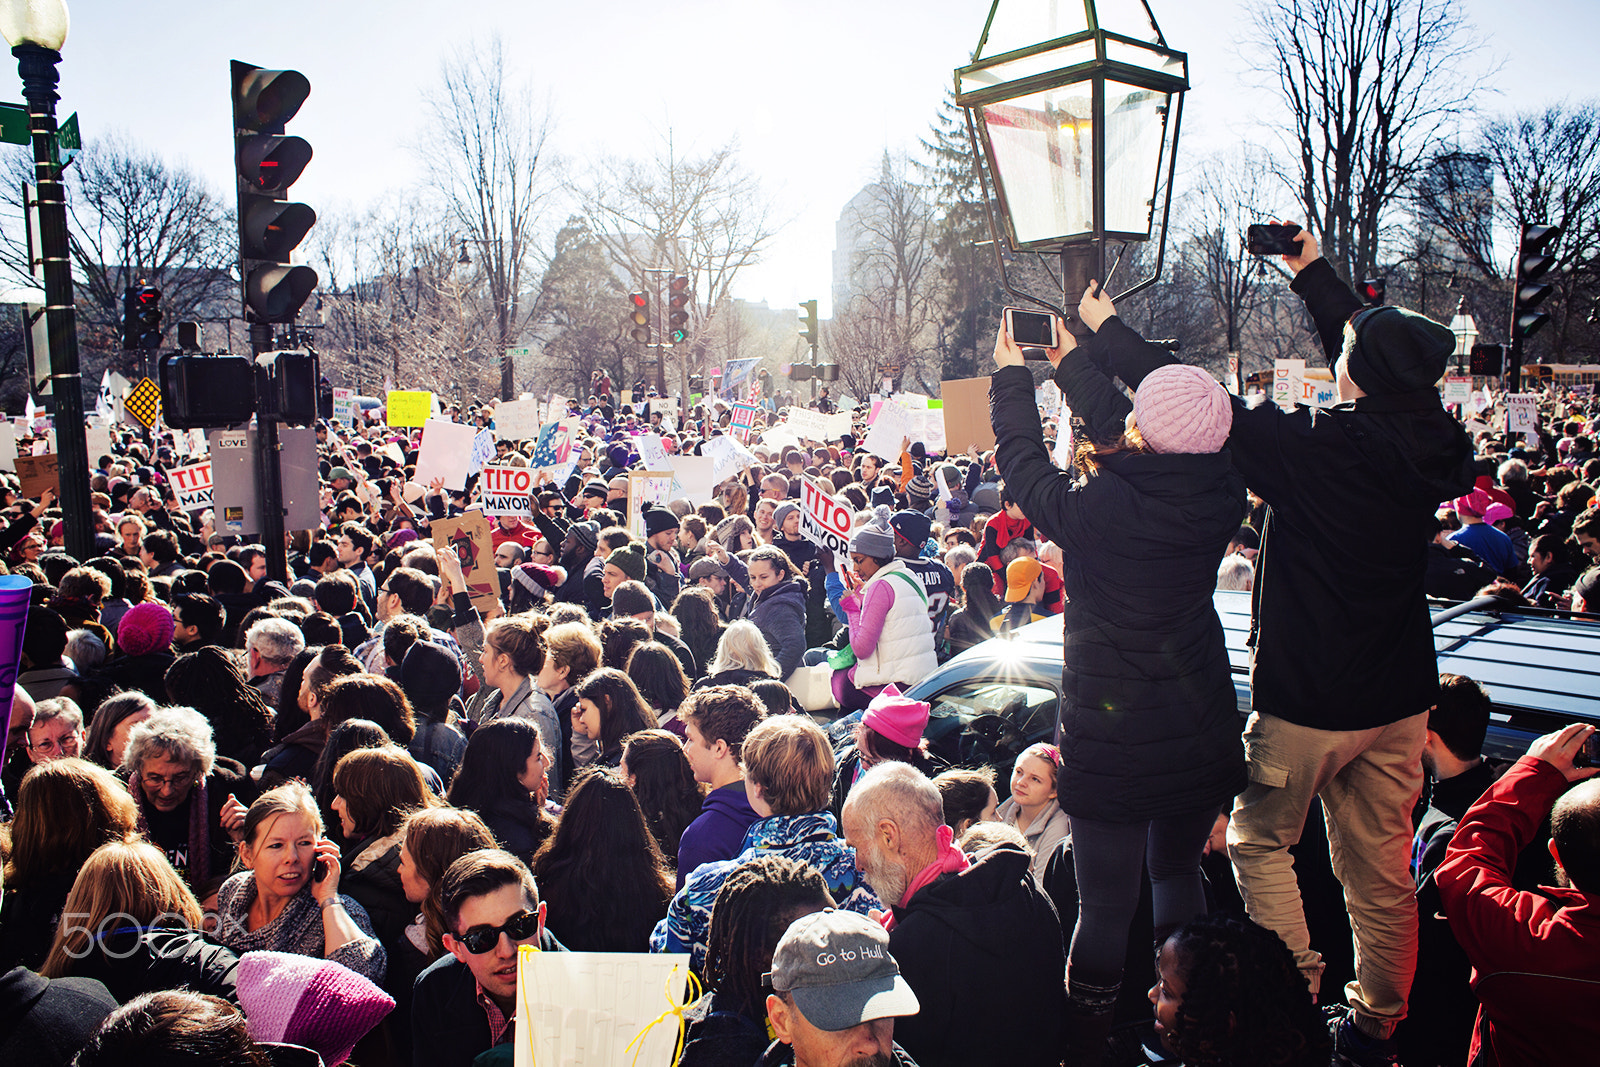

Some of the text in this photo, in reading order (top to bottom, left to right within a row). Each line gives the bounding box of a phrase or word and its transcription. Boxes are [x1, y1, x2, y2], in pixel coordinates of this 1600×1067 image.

[1302, 382, 1334, 404] IF Not
[1507, 397, 1535, 405] RESIST
[171, 465, 211, 489] TIT
[483, 468, 531, 492] TITO
[180, 488, 214, 506] MAY
[485, 496, 530, 511] MAYOR
[804, 480, 851, 533] TITO
[802, 512, 849, 559] MAYOR
[915, 571, 942, 586] RADY
[816, 944, 884, 967] Go to Hull
